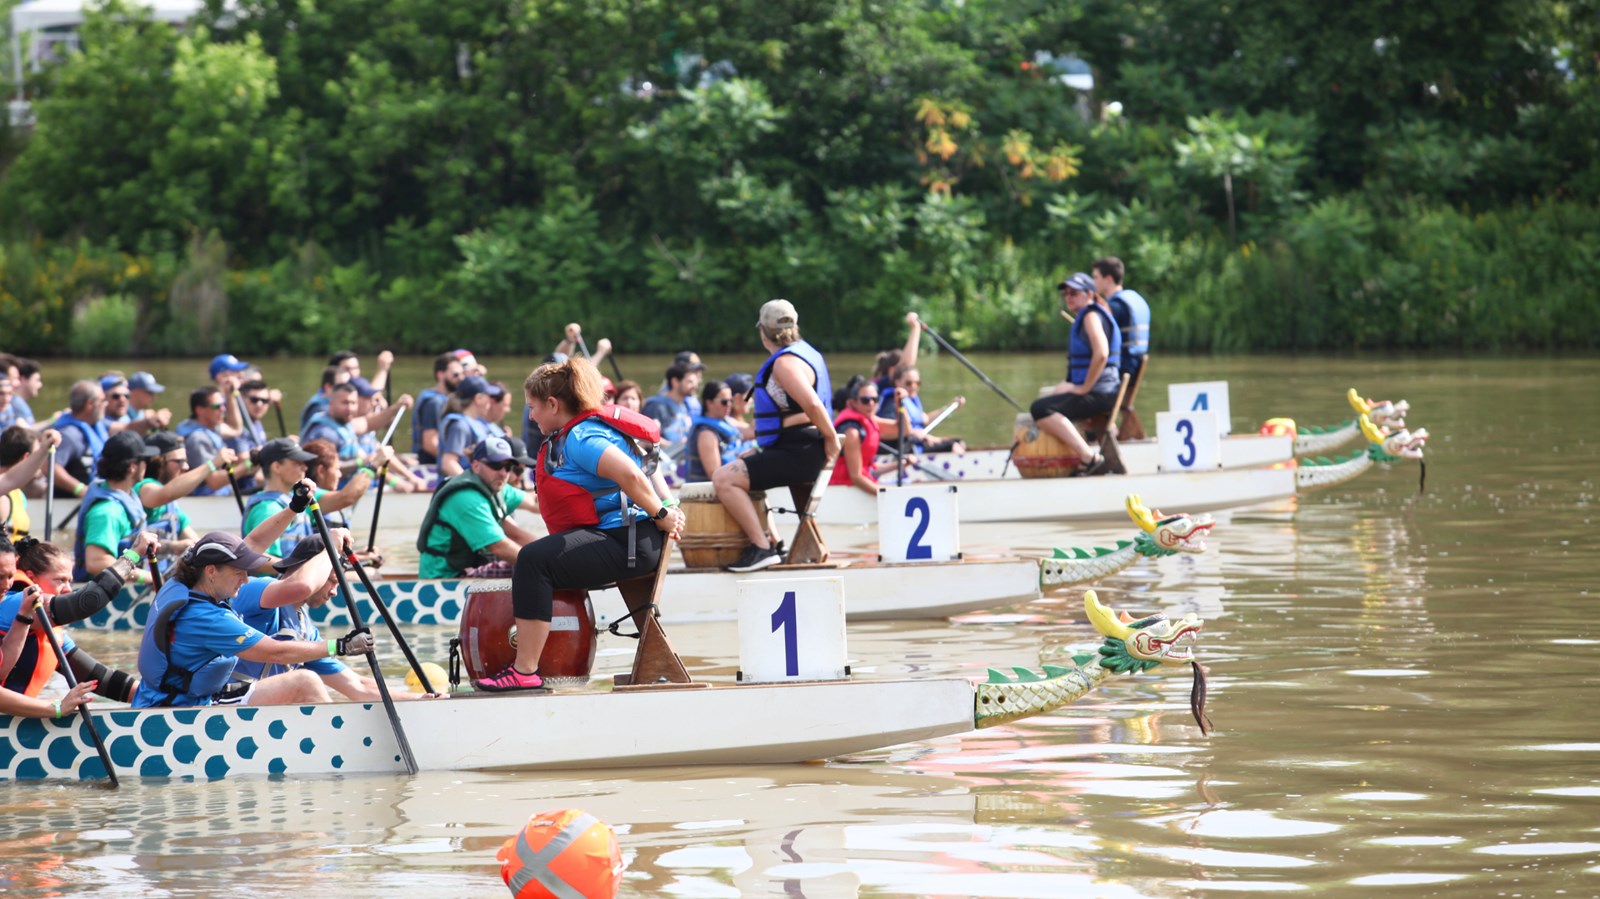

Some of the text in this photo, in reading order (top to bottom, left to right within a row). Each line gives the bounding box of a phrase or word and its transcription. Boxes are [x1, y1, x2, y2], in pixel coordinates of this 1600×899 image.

[1176, 420, 1195, 467] 3
[905, 497, 932, 559] 2
[771, 592, 798, 676] 1
